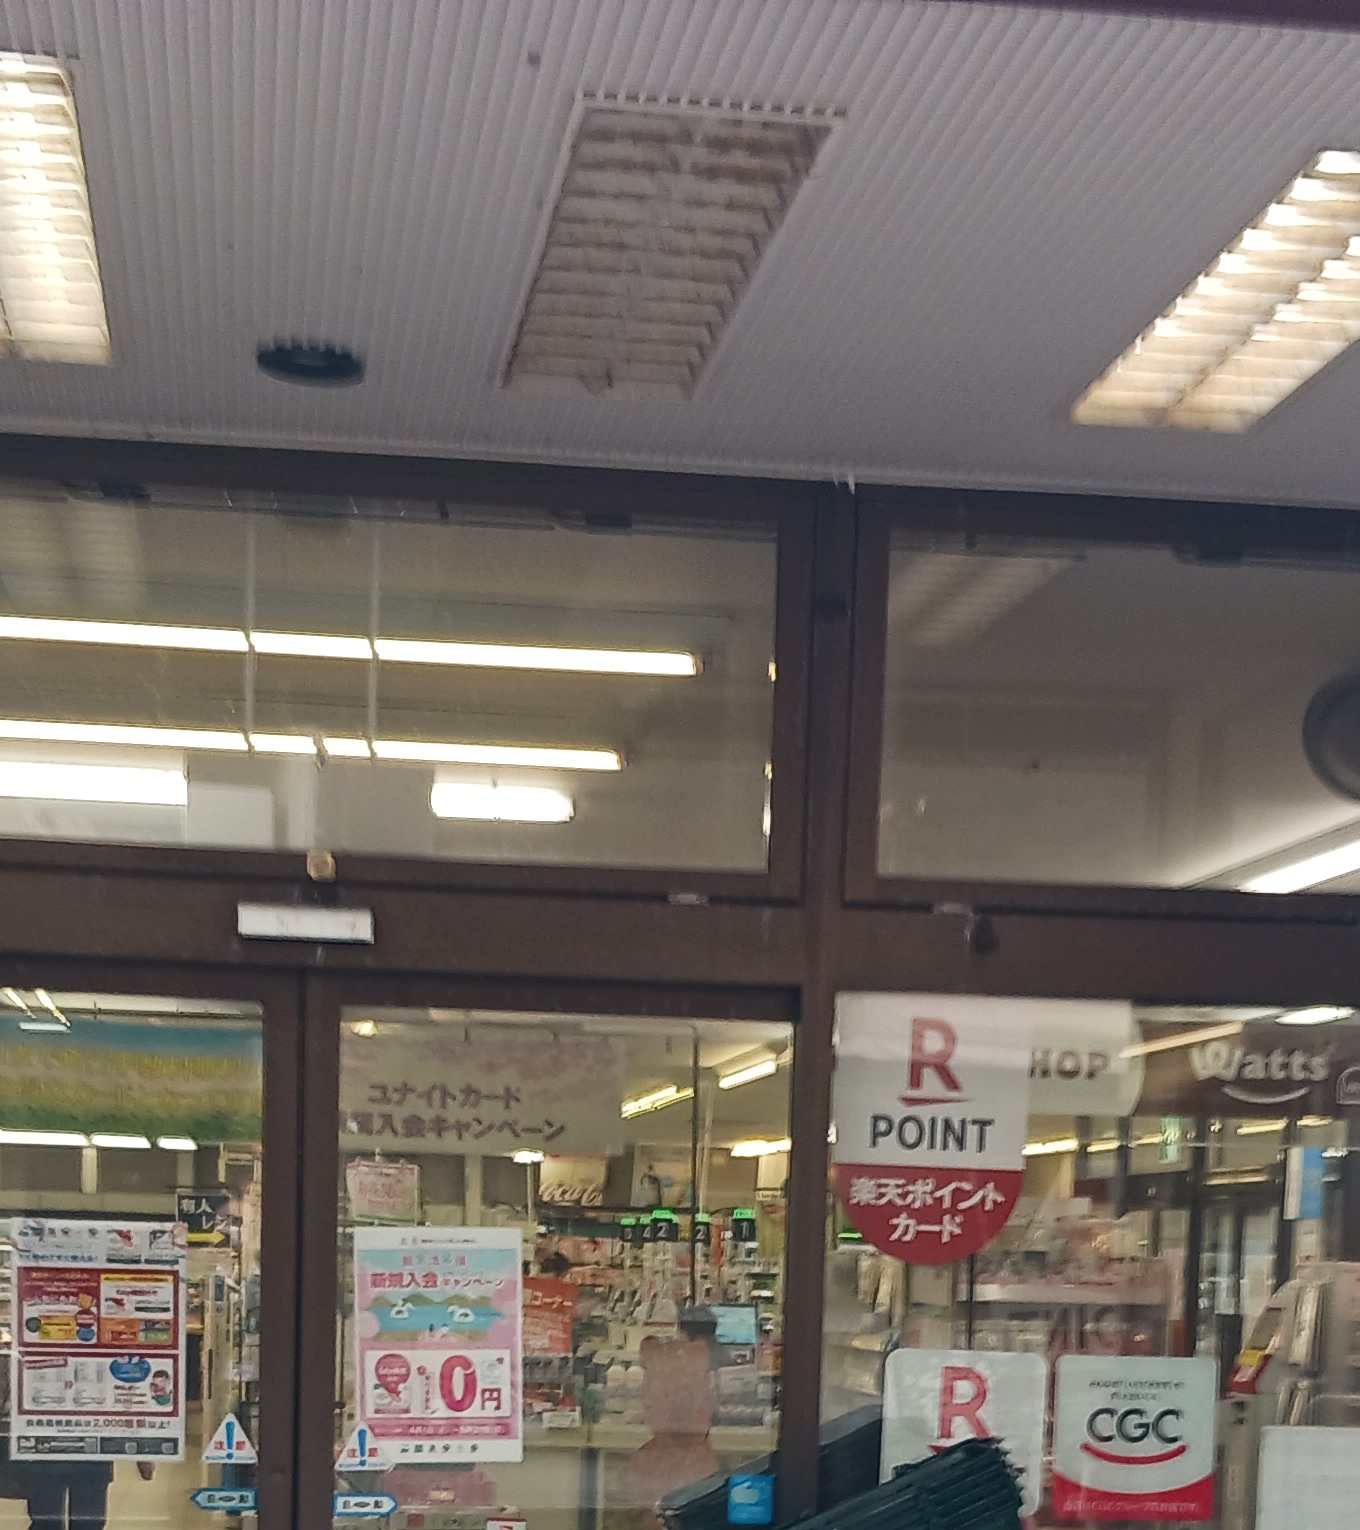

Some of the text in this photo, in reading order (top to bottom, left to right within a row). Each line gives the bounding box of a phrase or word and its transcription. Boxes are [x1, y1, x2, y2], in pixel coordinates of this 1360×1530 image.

[908, 1017, 962, 1090] R
[1029, 1048, 1110, 1080] HOP
[1191, 1042, 1331, 1081] Watts
[870, 1114, 995, 1152] POINT
[849, 1177, 1006, 1211] 楽天ポイント
[888, 1212, 966, 1244] カード
[938, 1366, 991, 1440] R
[1086, 1407, 1185, 1444] CGC
